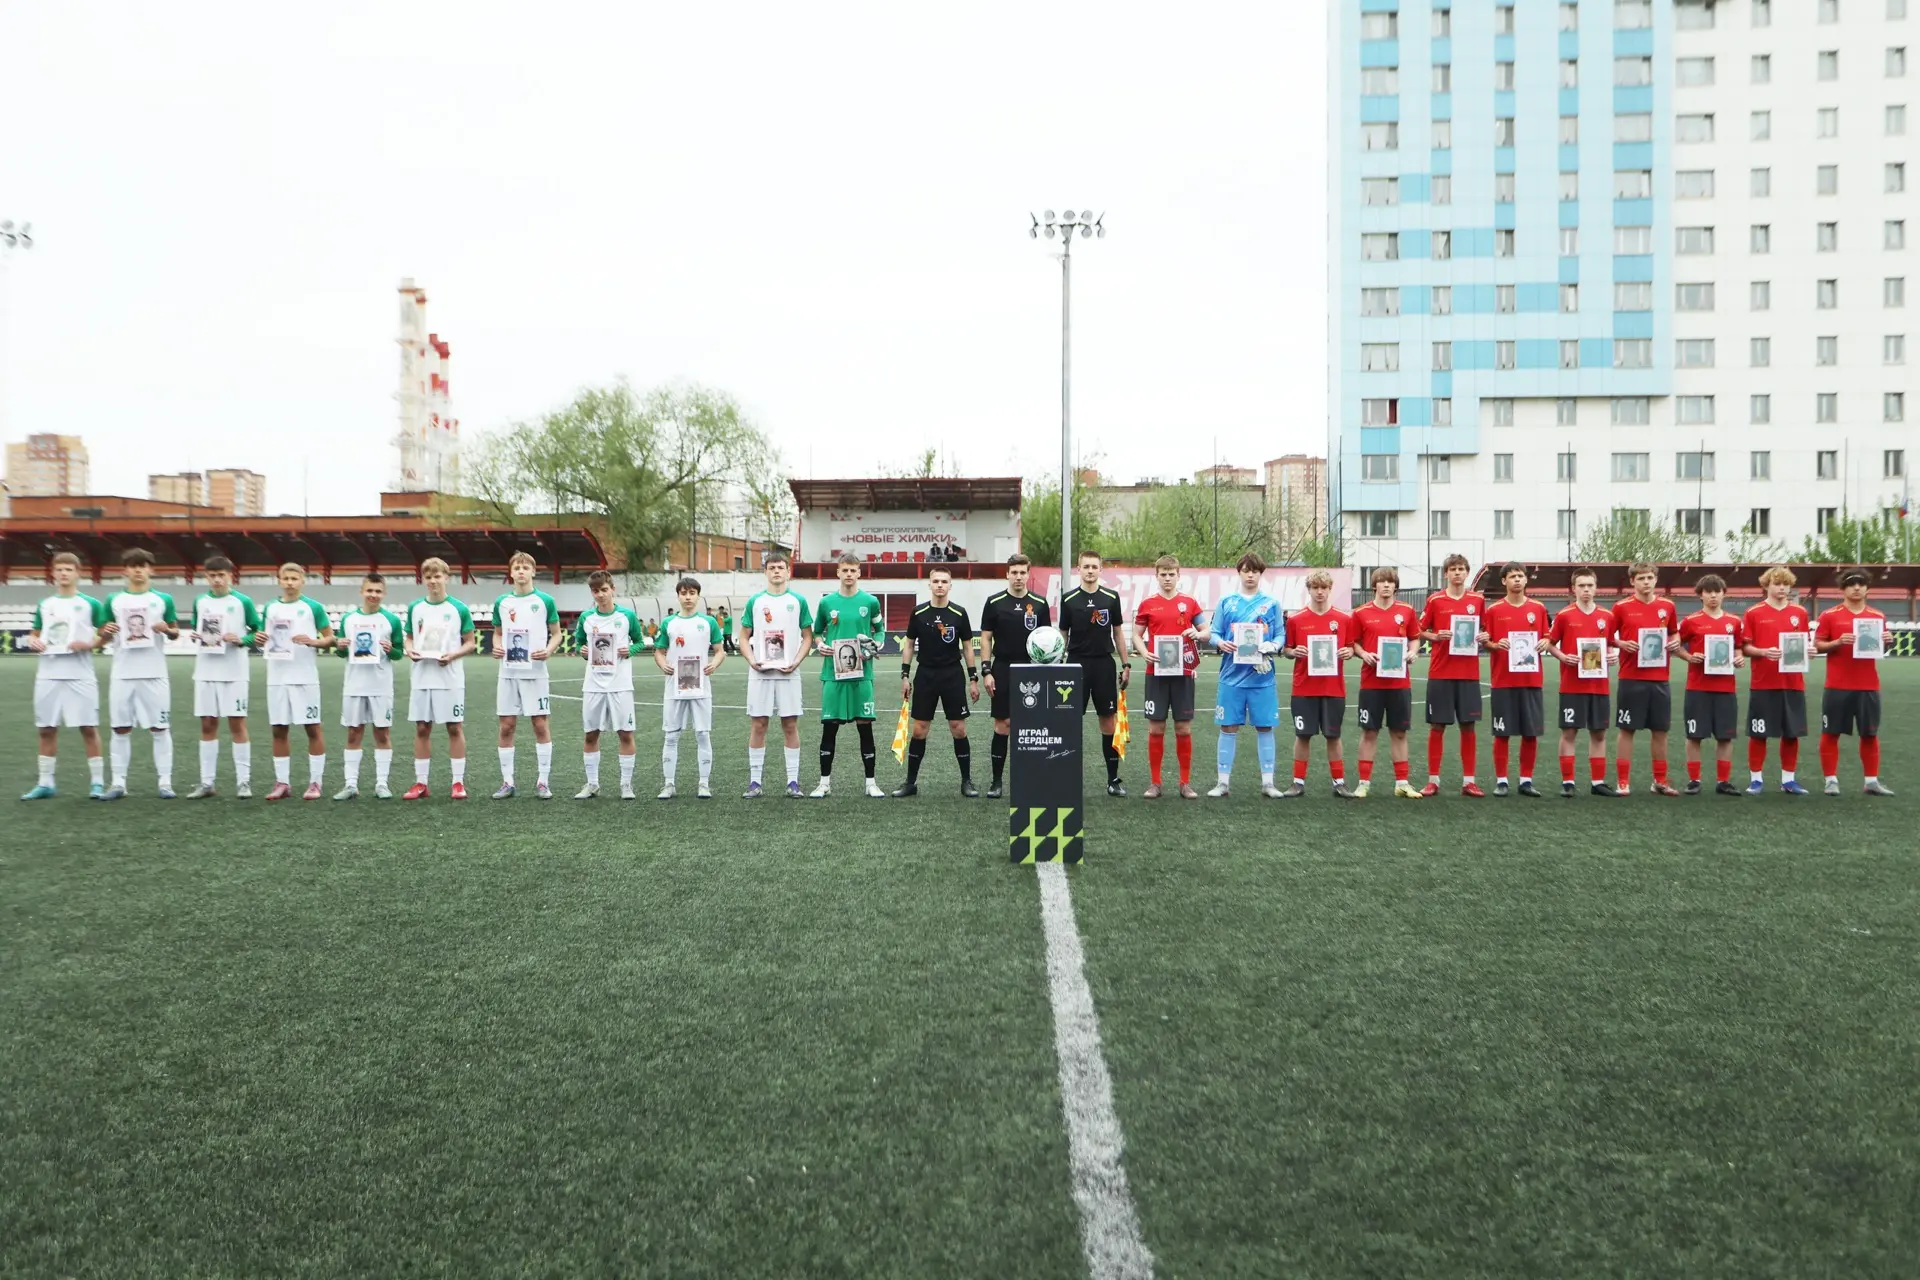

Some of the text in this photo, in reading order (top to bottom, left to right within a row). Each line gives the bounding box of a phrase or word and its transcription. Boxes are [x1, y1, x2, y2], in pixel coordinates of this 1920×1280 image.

[1563, 708, 1574, 722] 12
[1618, 709, 1631, 724] 24
[1018, 727, 1049, 737] ИГРАЙ
[1751, 719, 1765, 734] 88
[1018, 736, 1063, 746] СЕРДЦЕМ
